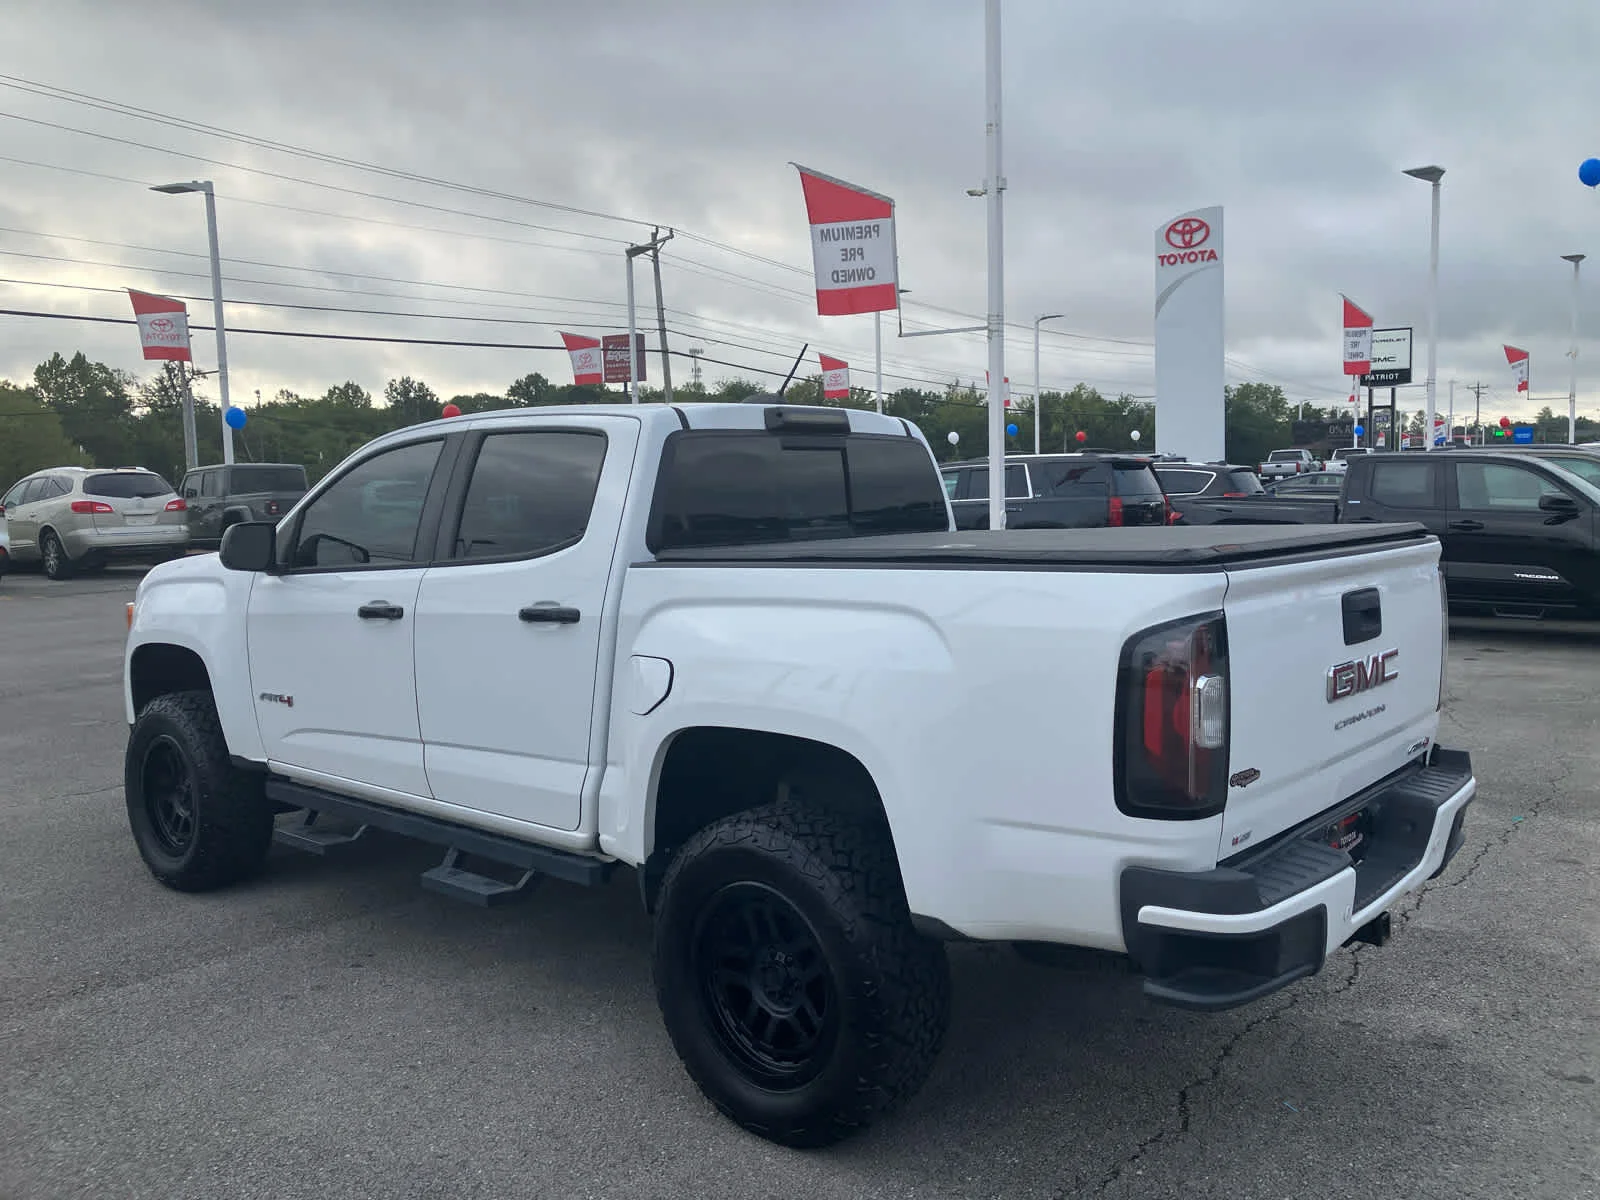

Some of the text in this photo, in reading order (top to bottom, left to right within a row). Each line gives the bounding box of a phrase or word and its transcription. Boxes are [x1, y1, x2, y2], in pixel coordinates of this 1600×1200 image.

[1157, 249, 1218, 267] TOYOTA
[1364, 373, 1400, 381] PATRIOT
[1327, 648, 1399, 704] GMC
